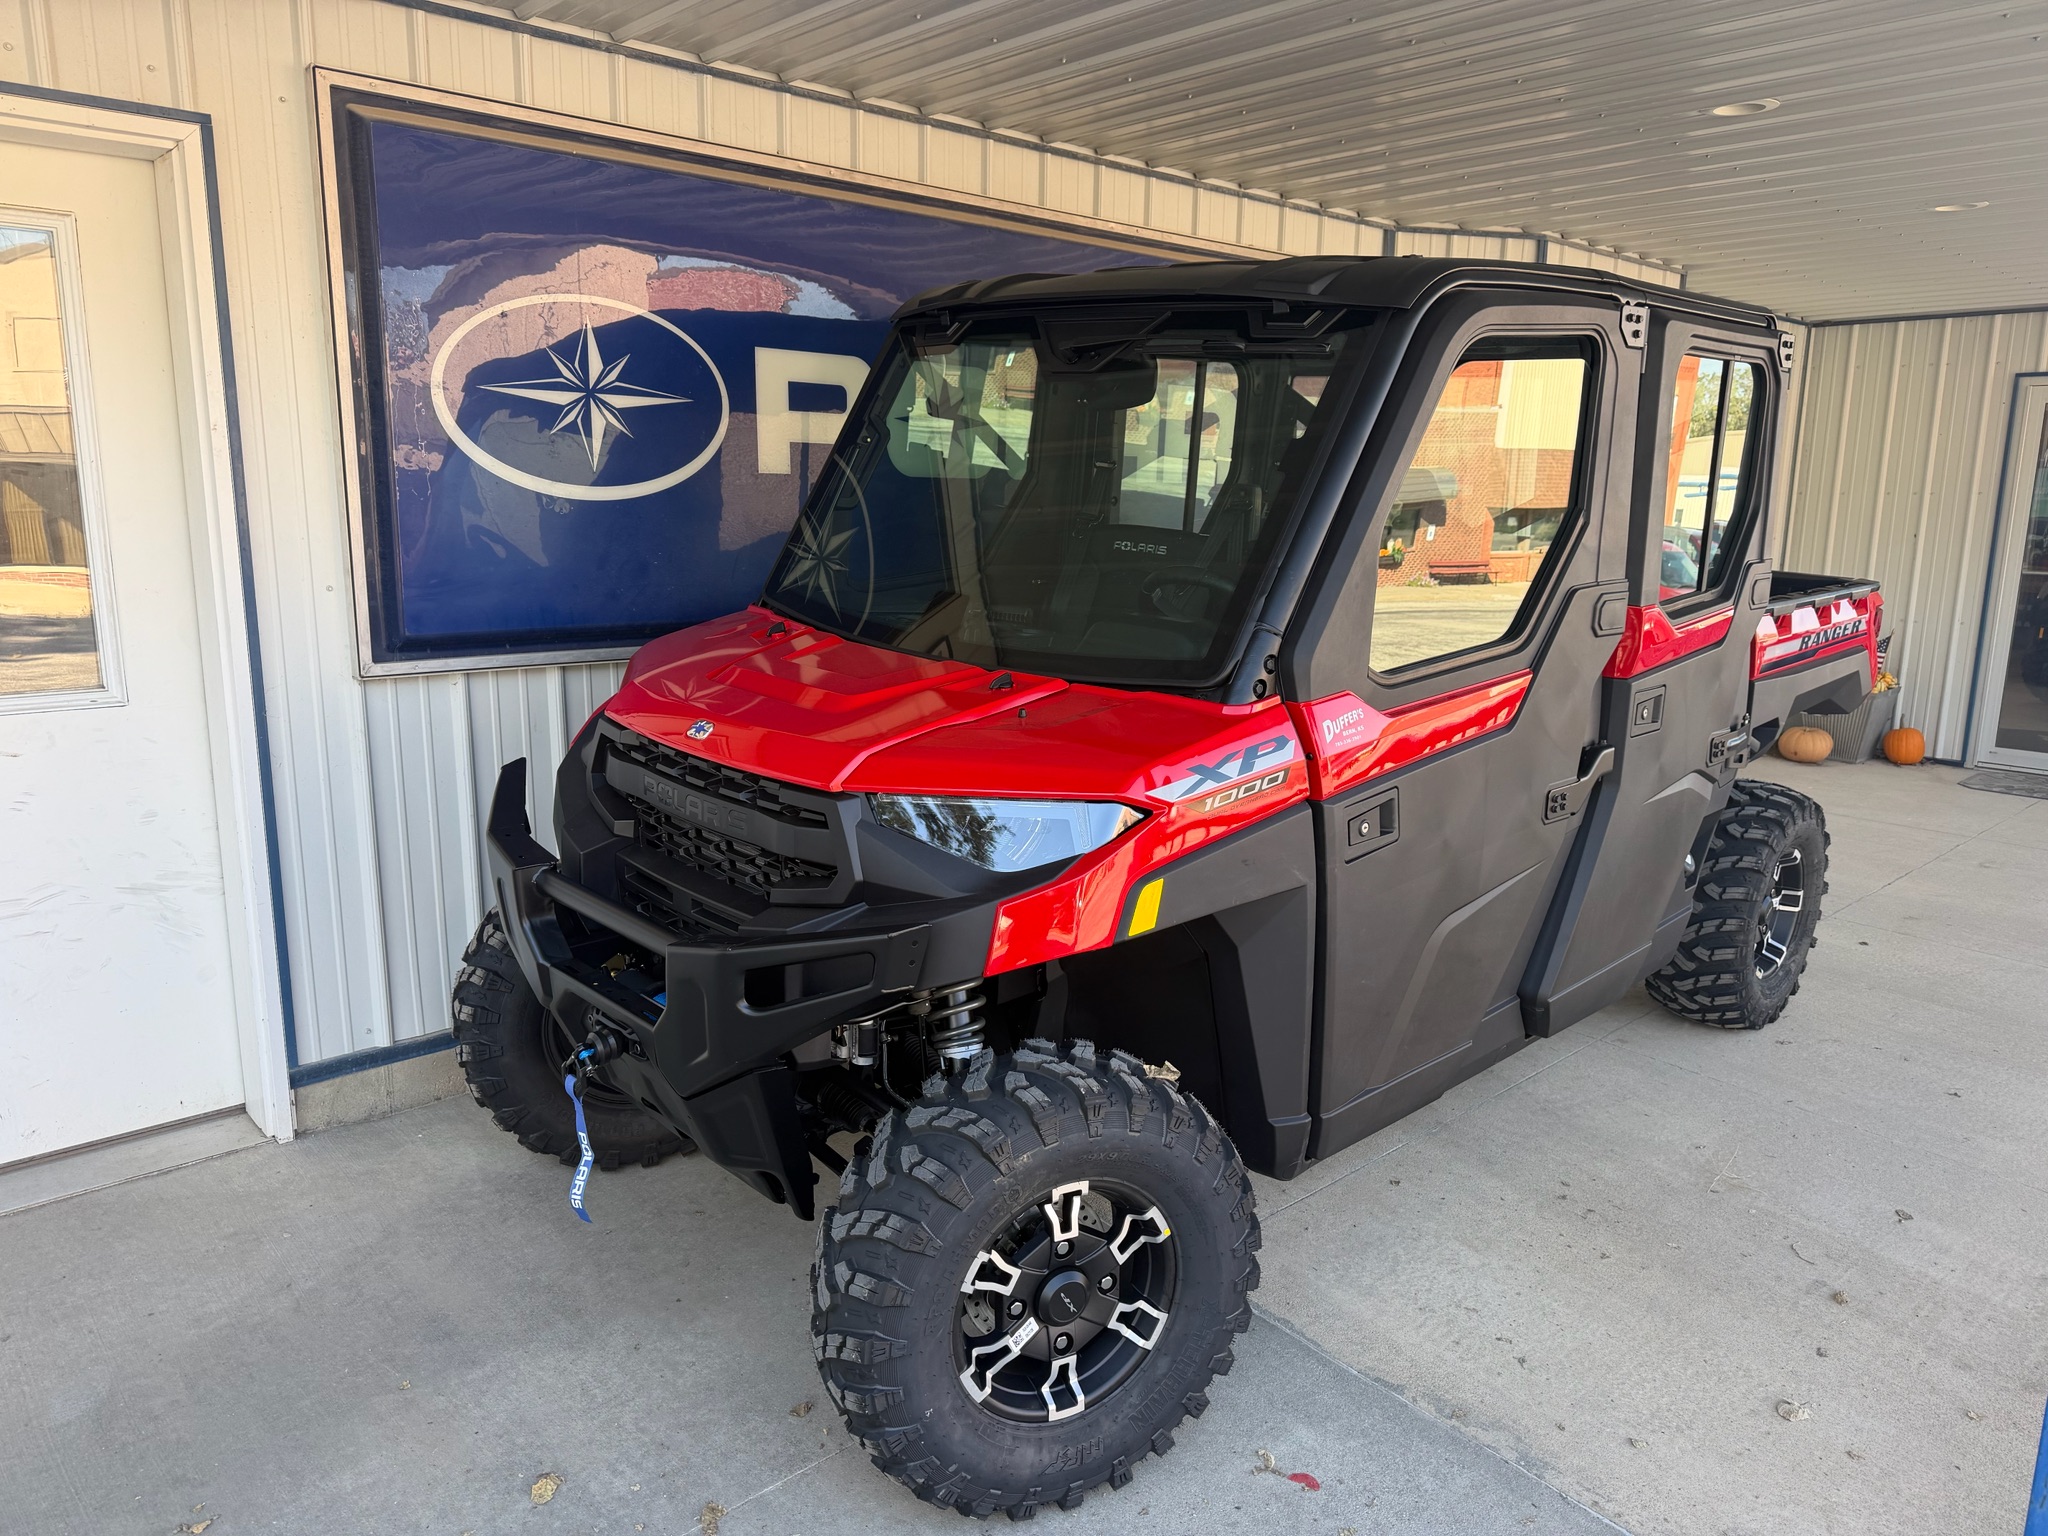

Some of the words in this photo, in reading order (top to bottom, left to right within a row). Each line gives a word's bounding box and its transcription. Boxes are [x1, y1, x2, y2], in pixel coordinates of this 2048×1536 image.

[1113, 541, 1167, 555] POLARIS
[1799, 619, 1862, 652] RANGER
[1322, 708, 1364, 744] DUFFER'S
[1175, 735, 1291, 799] XP
[643, 774, 748, 837] POLARIS
[1204, 770, 1285, 812] 1000
[570, 1131, 595, 1210] POLARIS
